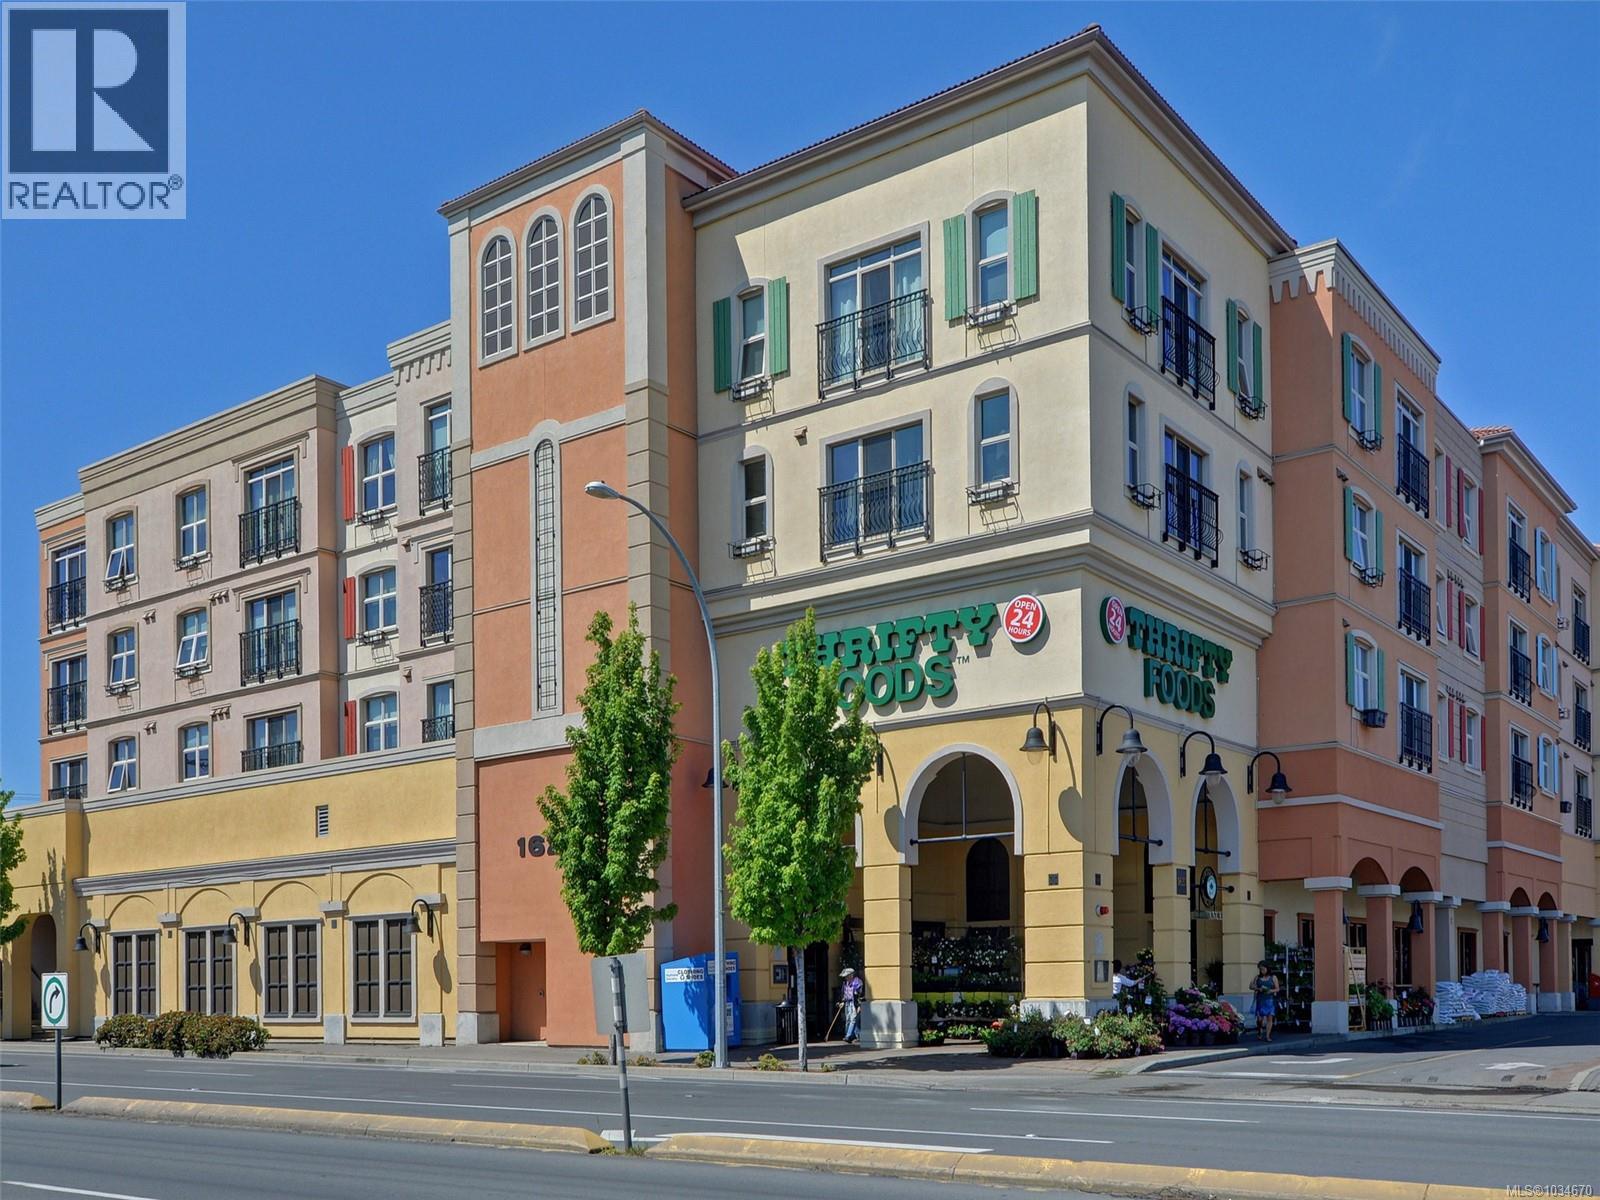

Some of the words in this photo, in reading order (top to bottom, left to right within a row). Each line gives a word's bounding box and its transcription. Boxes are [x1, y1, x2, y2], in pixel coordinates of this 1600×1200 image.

[1008, 626, 1032, 637] HOURS
[1010, 608, 1034, 629] 24
[1014, 600, 1037, 611] OPEN
[784, 602, 998, 677] HRIFTY
[1124, 606, 1233, 684] THRIFTY
[837, 655, 956, 711] OODS
[1143, 657, 1216, 719] FOODS
